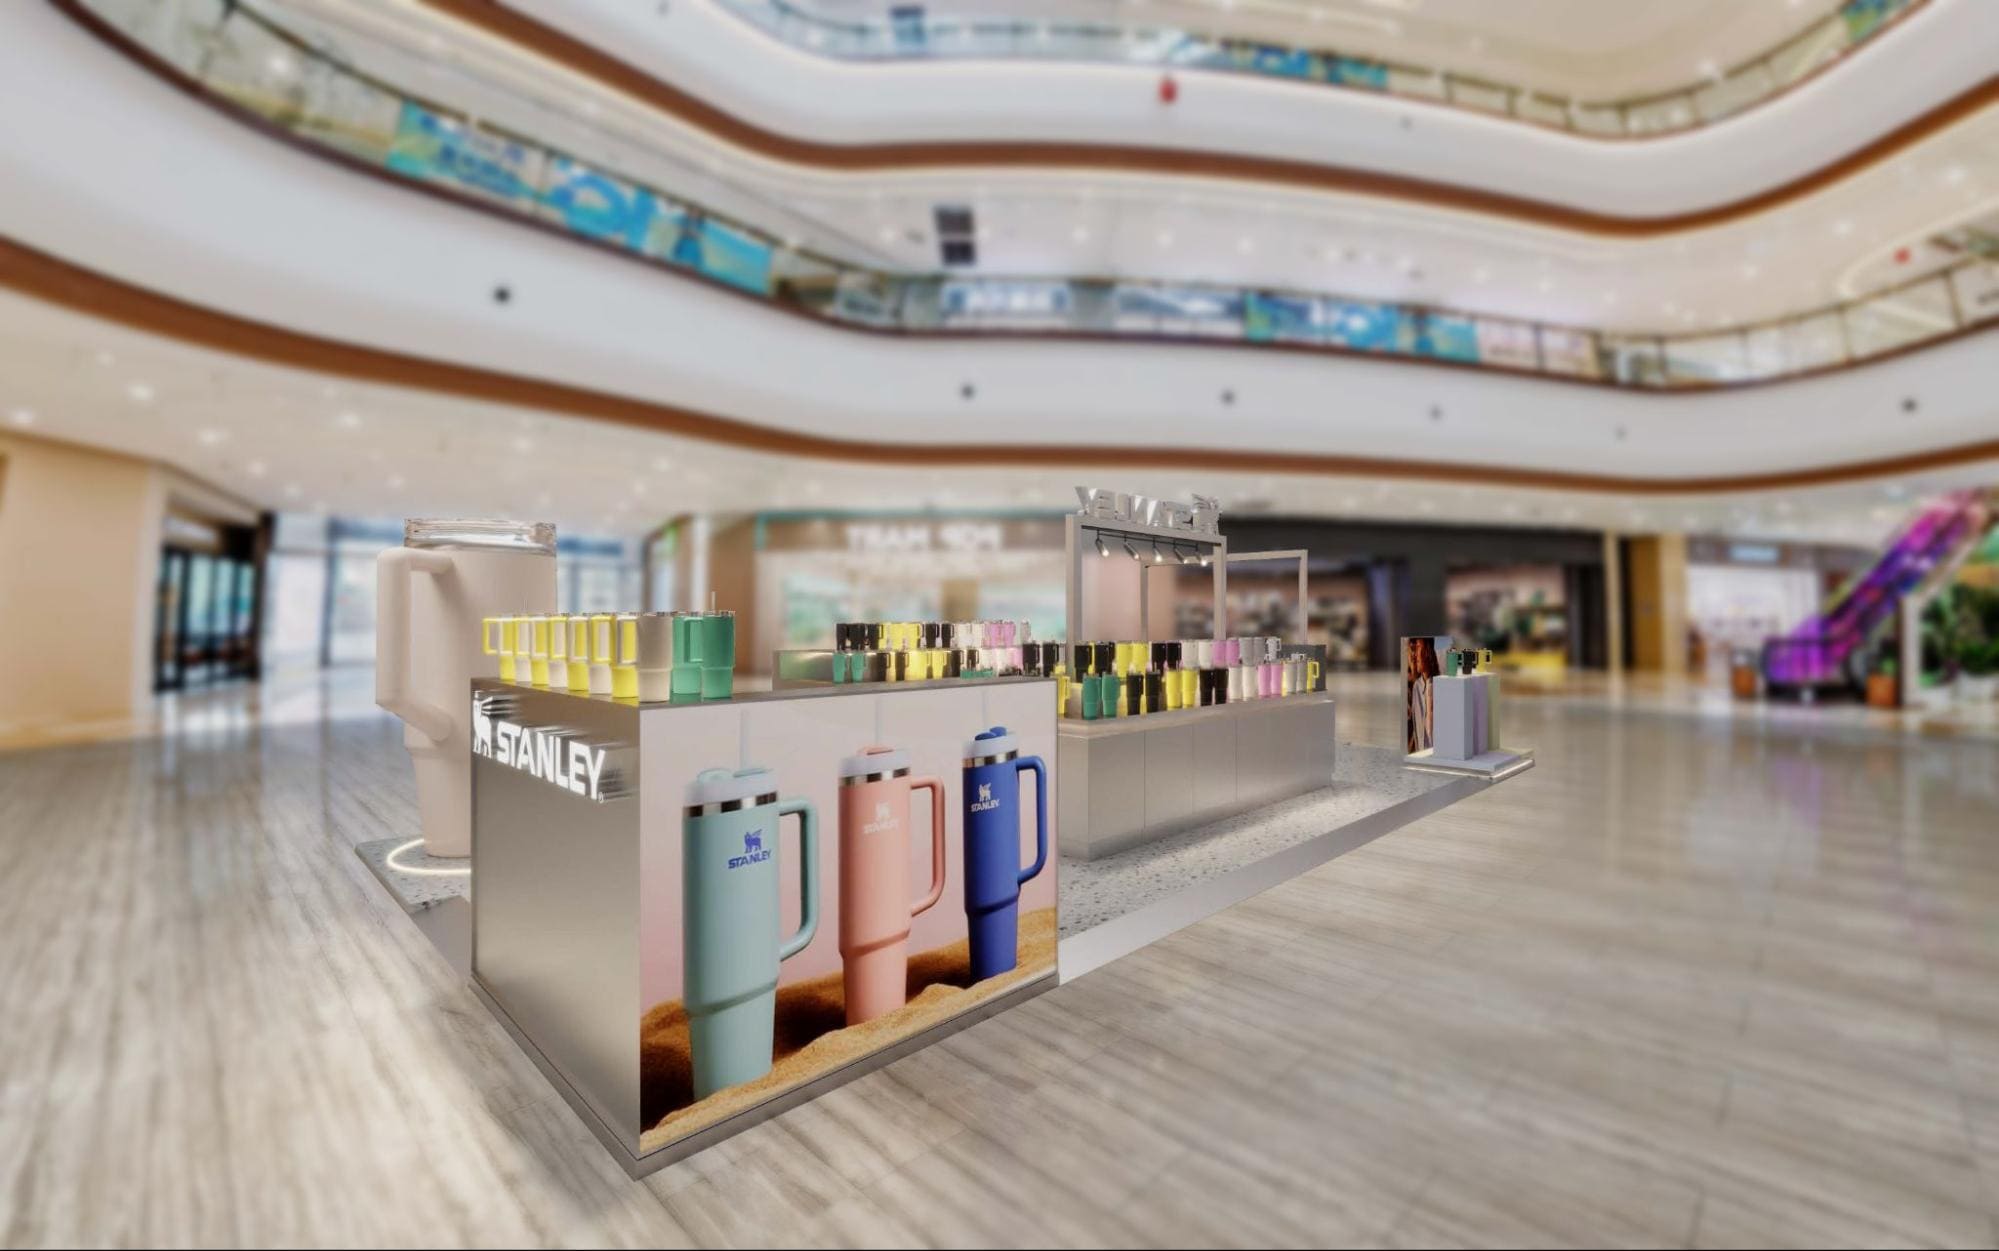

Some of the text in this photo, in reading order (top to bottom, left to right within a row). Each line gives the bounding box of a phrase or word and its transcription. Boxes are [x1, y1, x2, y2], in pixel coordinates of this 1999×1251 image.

[497, 720, 605, 800] STANLEY
[970, 798, 1000, 812] STANLEY
[728, 849, 771, 870] STANLEY
